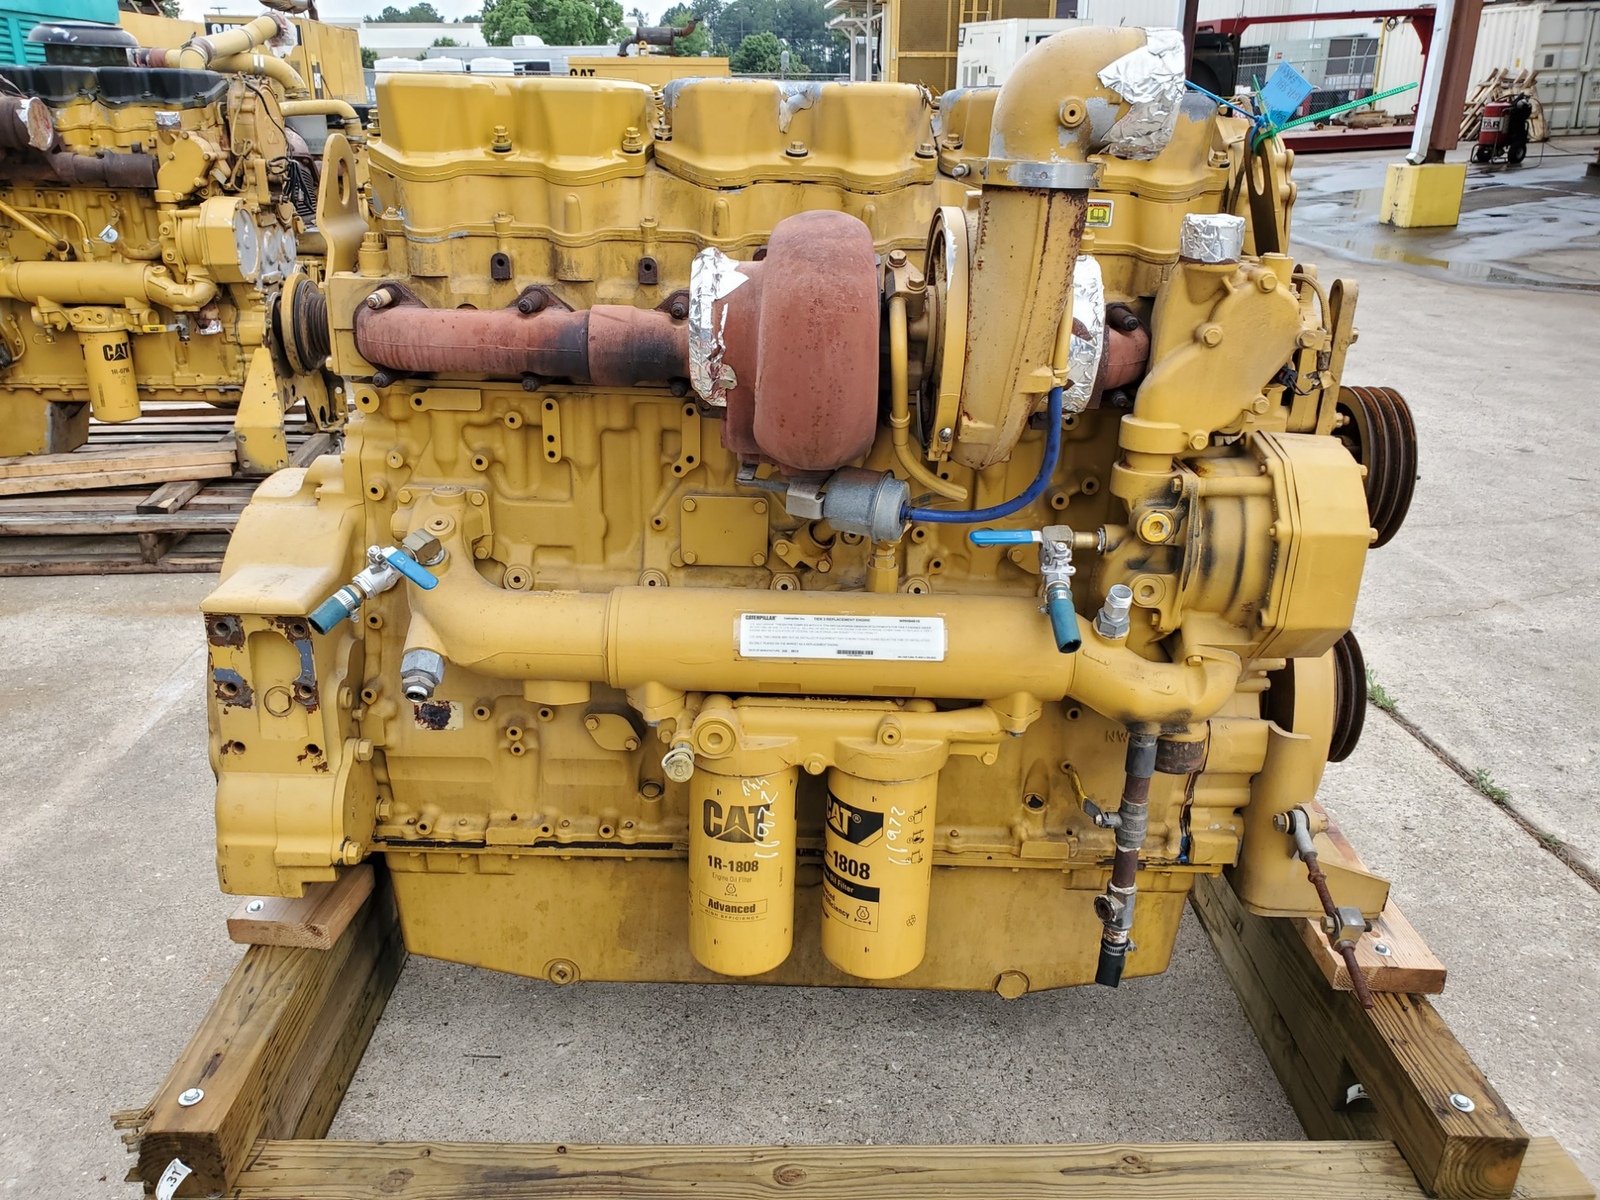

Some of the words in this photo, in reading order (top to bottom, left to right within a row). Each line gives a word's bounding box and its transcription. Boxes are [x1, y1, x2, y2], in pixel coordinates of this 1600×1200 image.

[102, 342, 129, 362] CAT
[703, 799, 771, 843] CAT
[707, 855, 759, 873] 1R-1808
[712, 872, 729, 882] Engine
[837, 880, 854, 893] Filter
[704, 909, 719, 917] HIGH
[707, 898, 756, 914] Advanced
